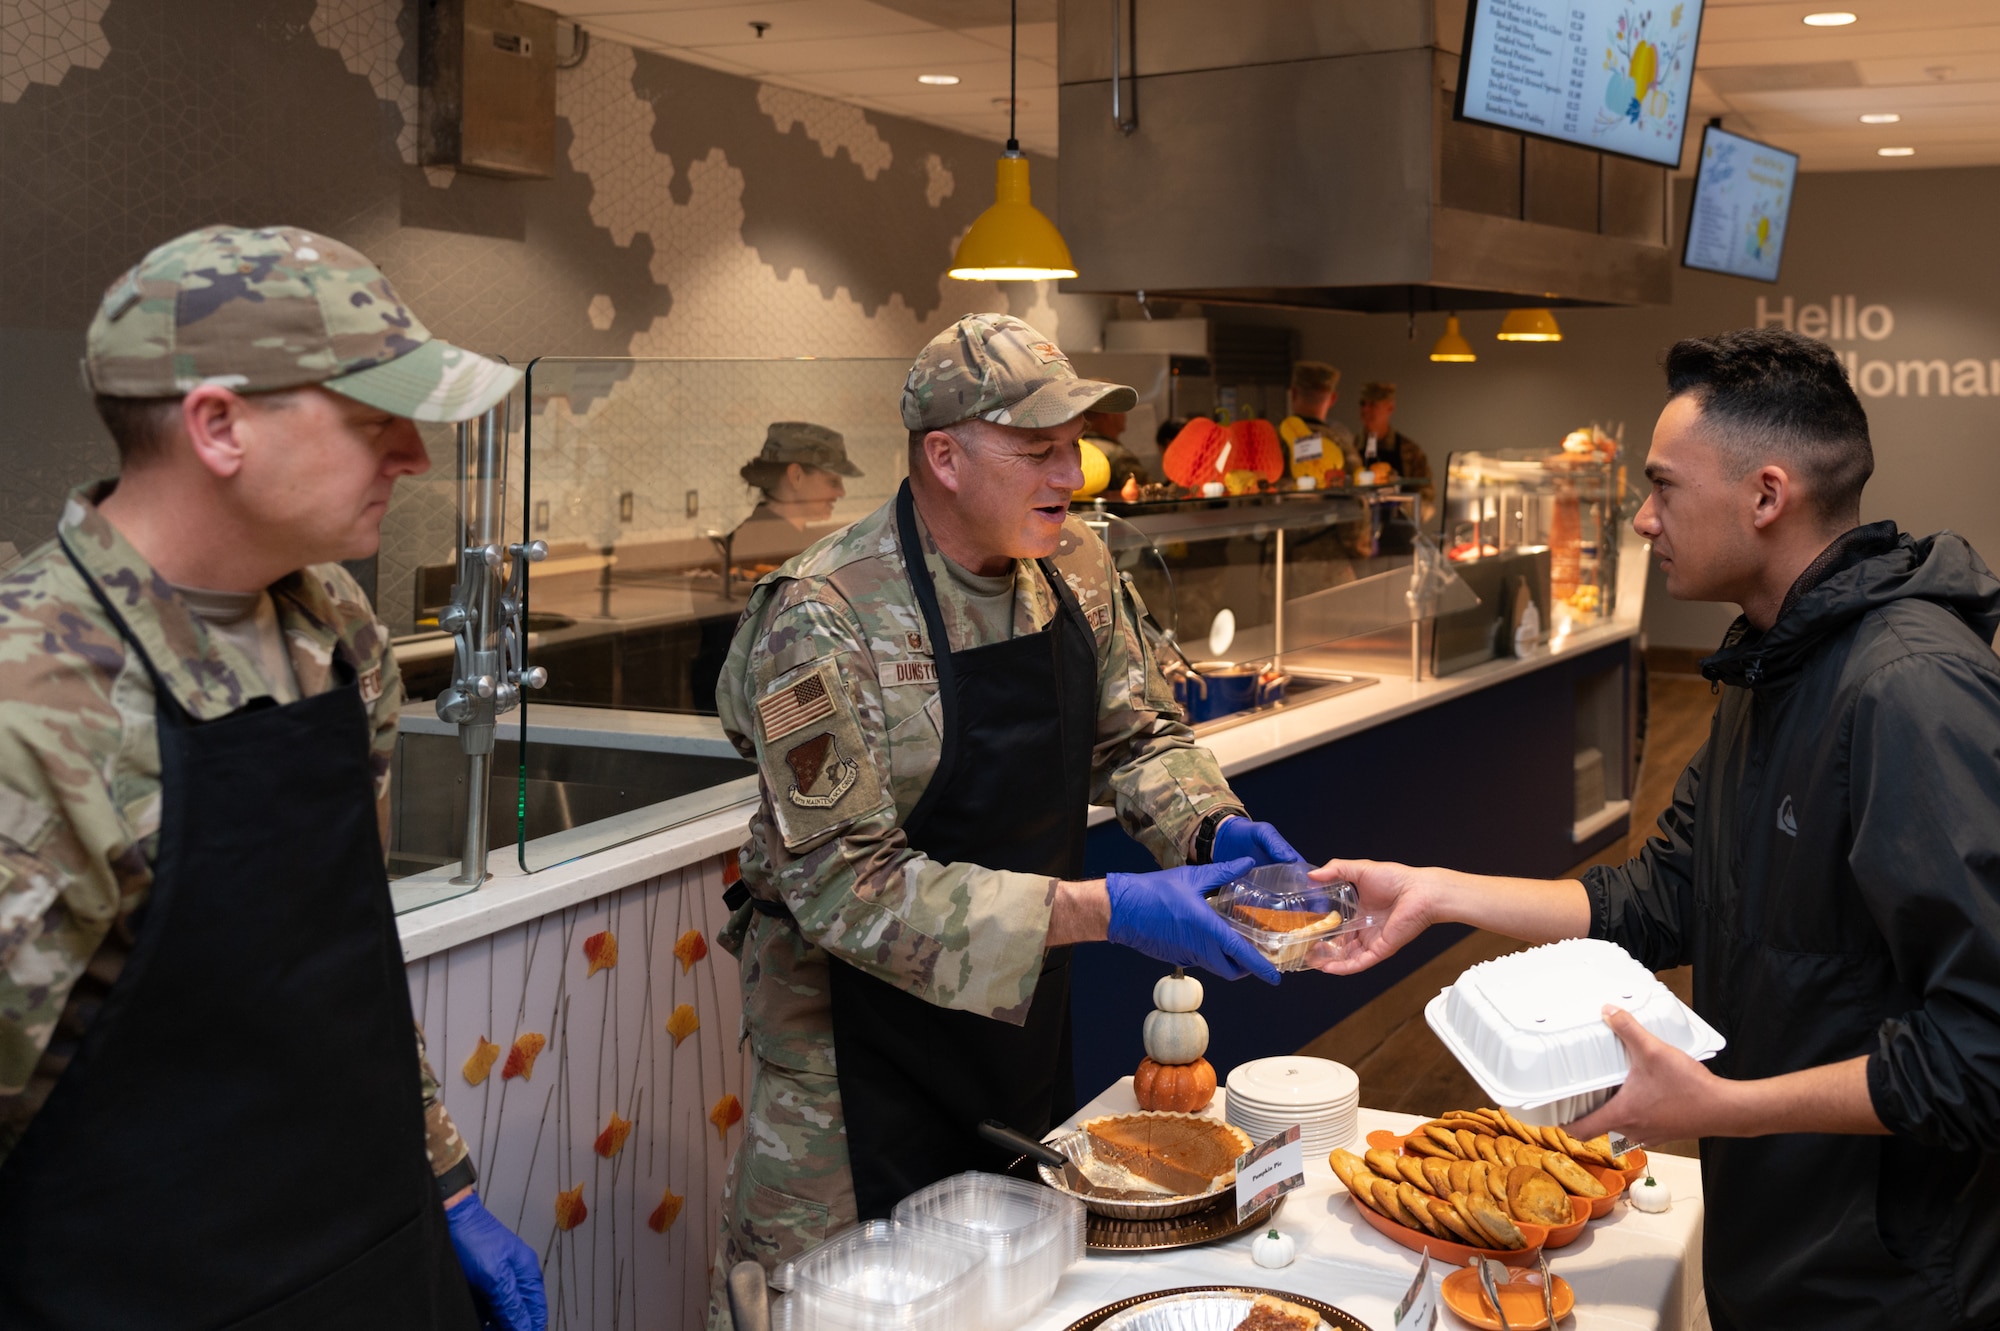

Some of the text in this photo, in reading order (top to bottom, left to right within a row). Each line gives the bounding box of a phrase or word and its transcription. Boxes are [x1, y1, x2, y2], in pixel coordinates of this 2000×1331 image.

[1756, 296, 1895, 341] Hello
[1842, 351, 2000, 398] loma
[896, 663, 939, 682] DUNSTO
[1252, 1161, 1282, 1182] Pumpkin Pie
